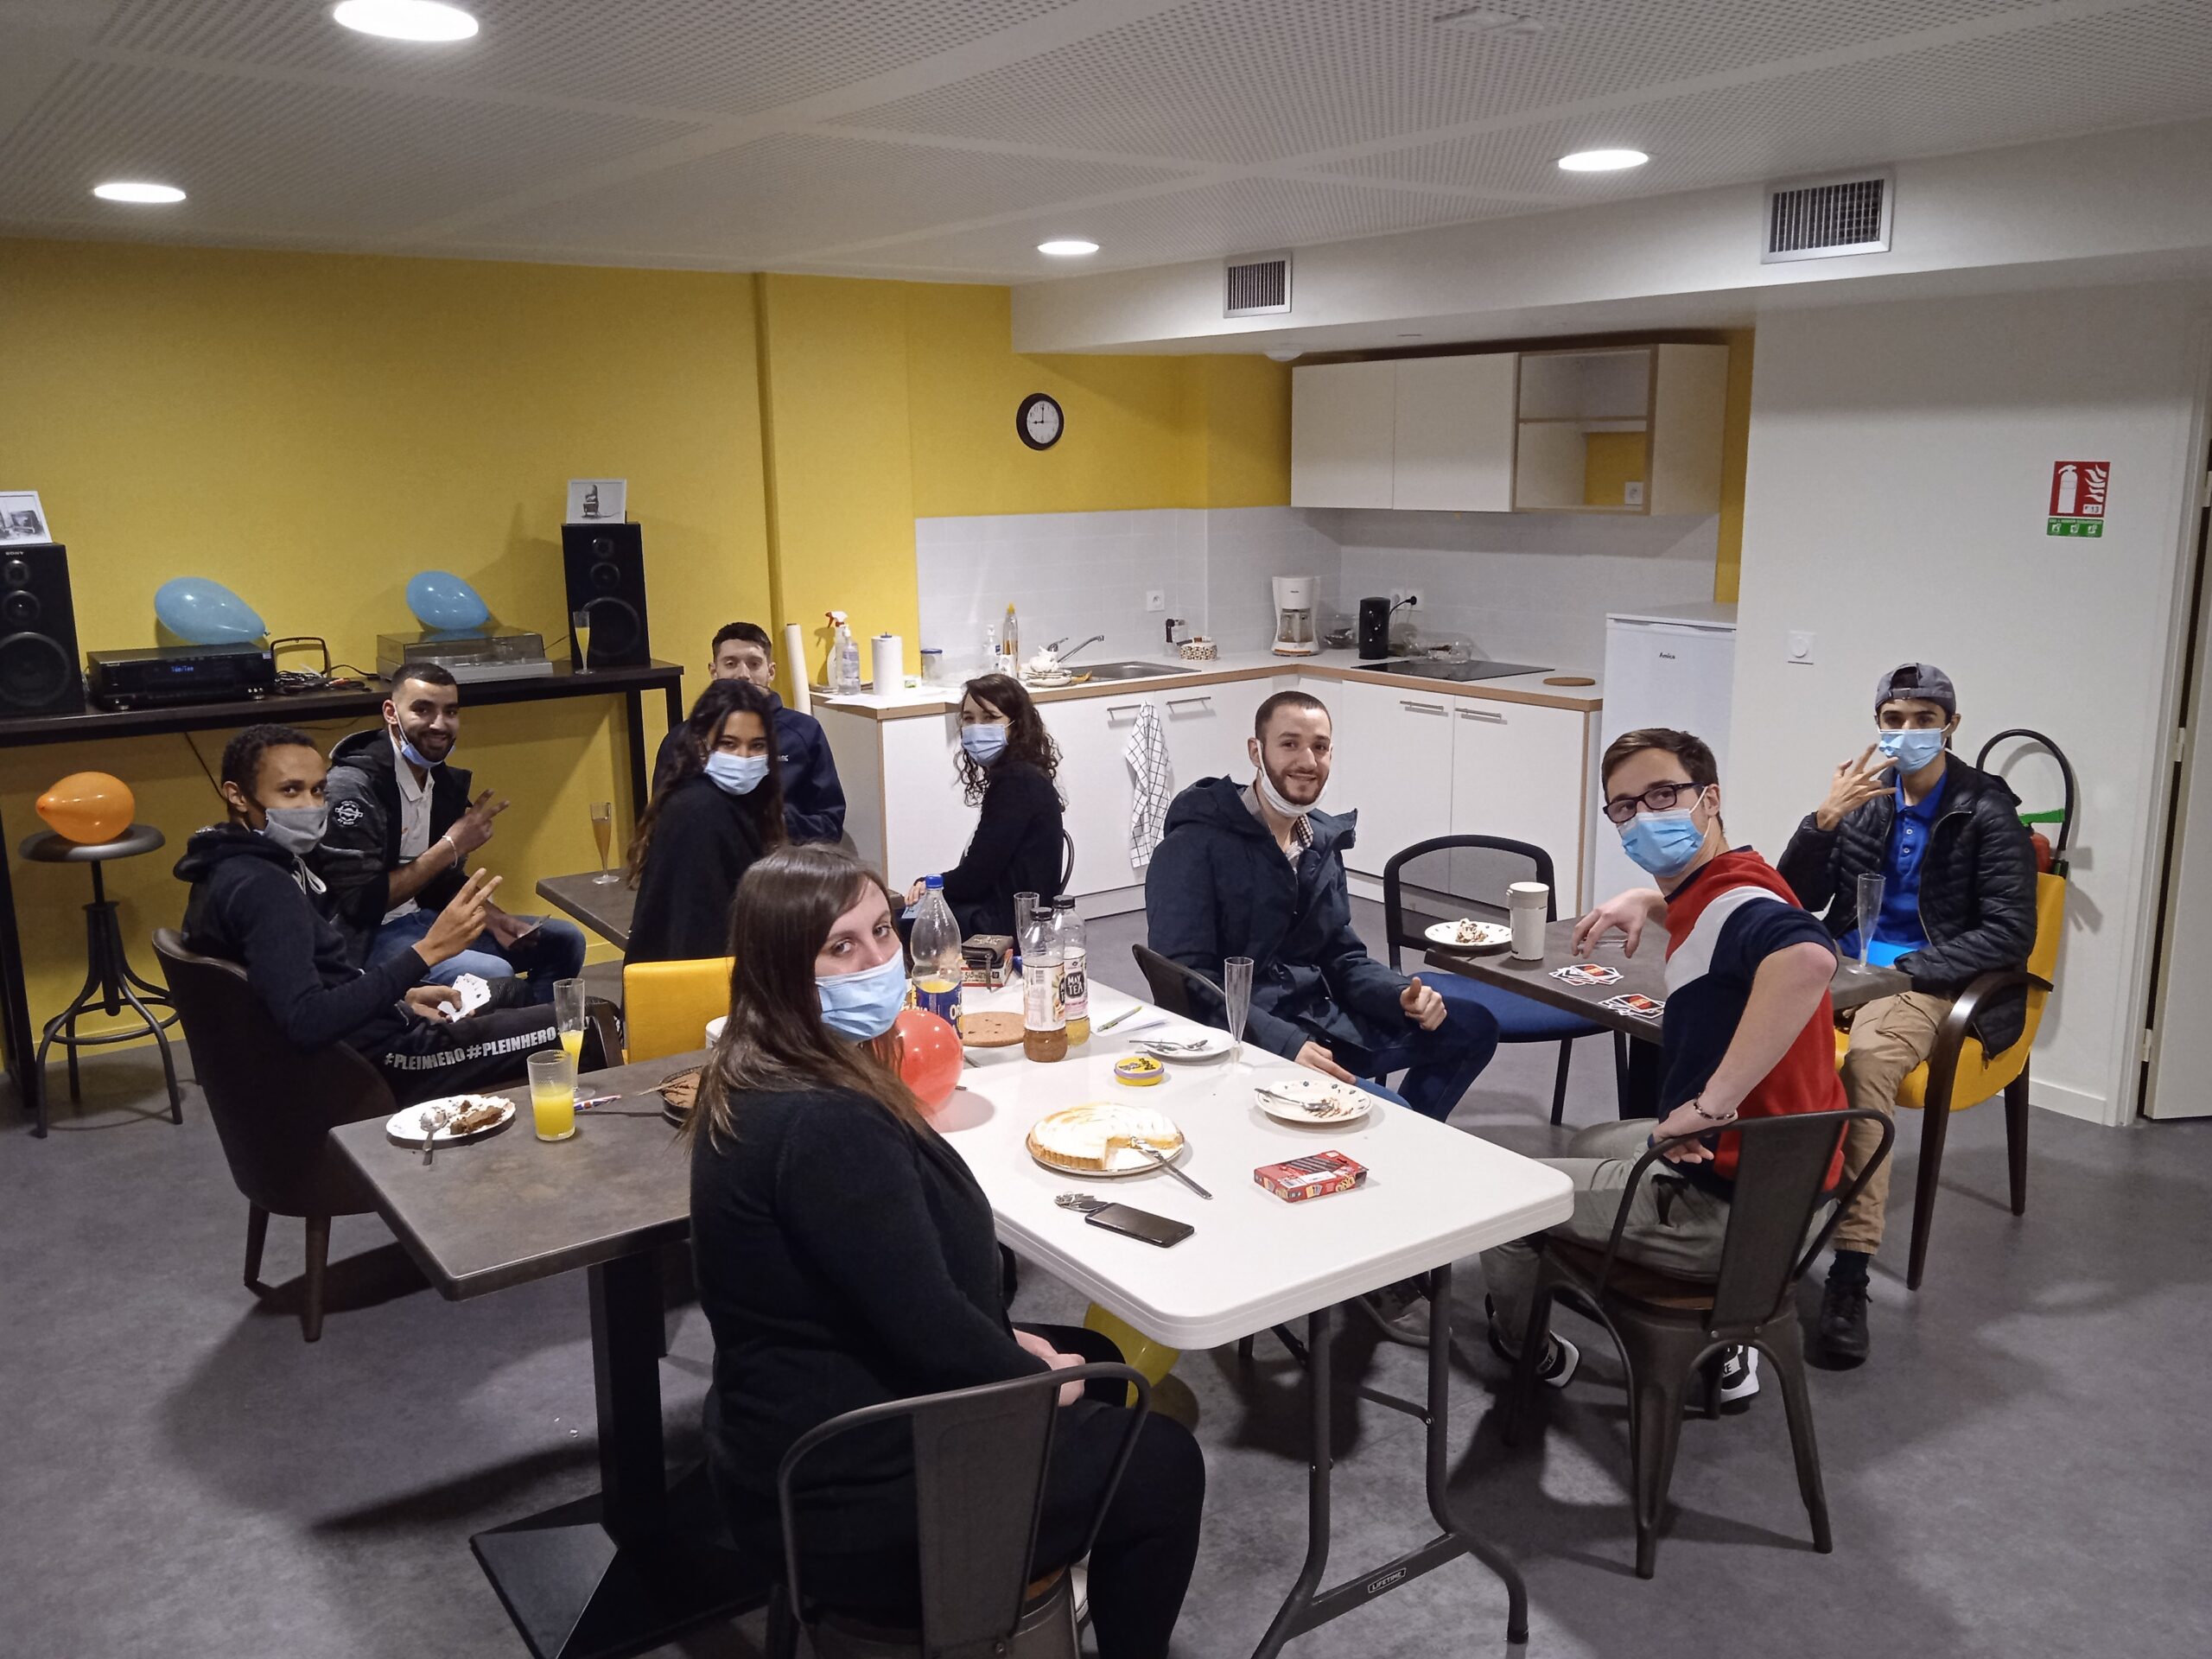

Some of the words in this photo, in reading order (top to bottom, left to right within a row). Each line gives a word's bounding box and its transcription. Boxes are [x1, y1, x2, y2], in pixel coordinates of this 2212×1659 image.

[1068, 982, 1084, 995] TEA
[467, 1026, 556, 1059] #PLEINHERO
[1371, 1571, 1403, 1591] LIFETIME
